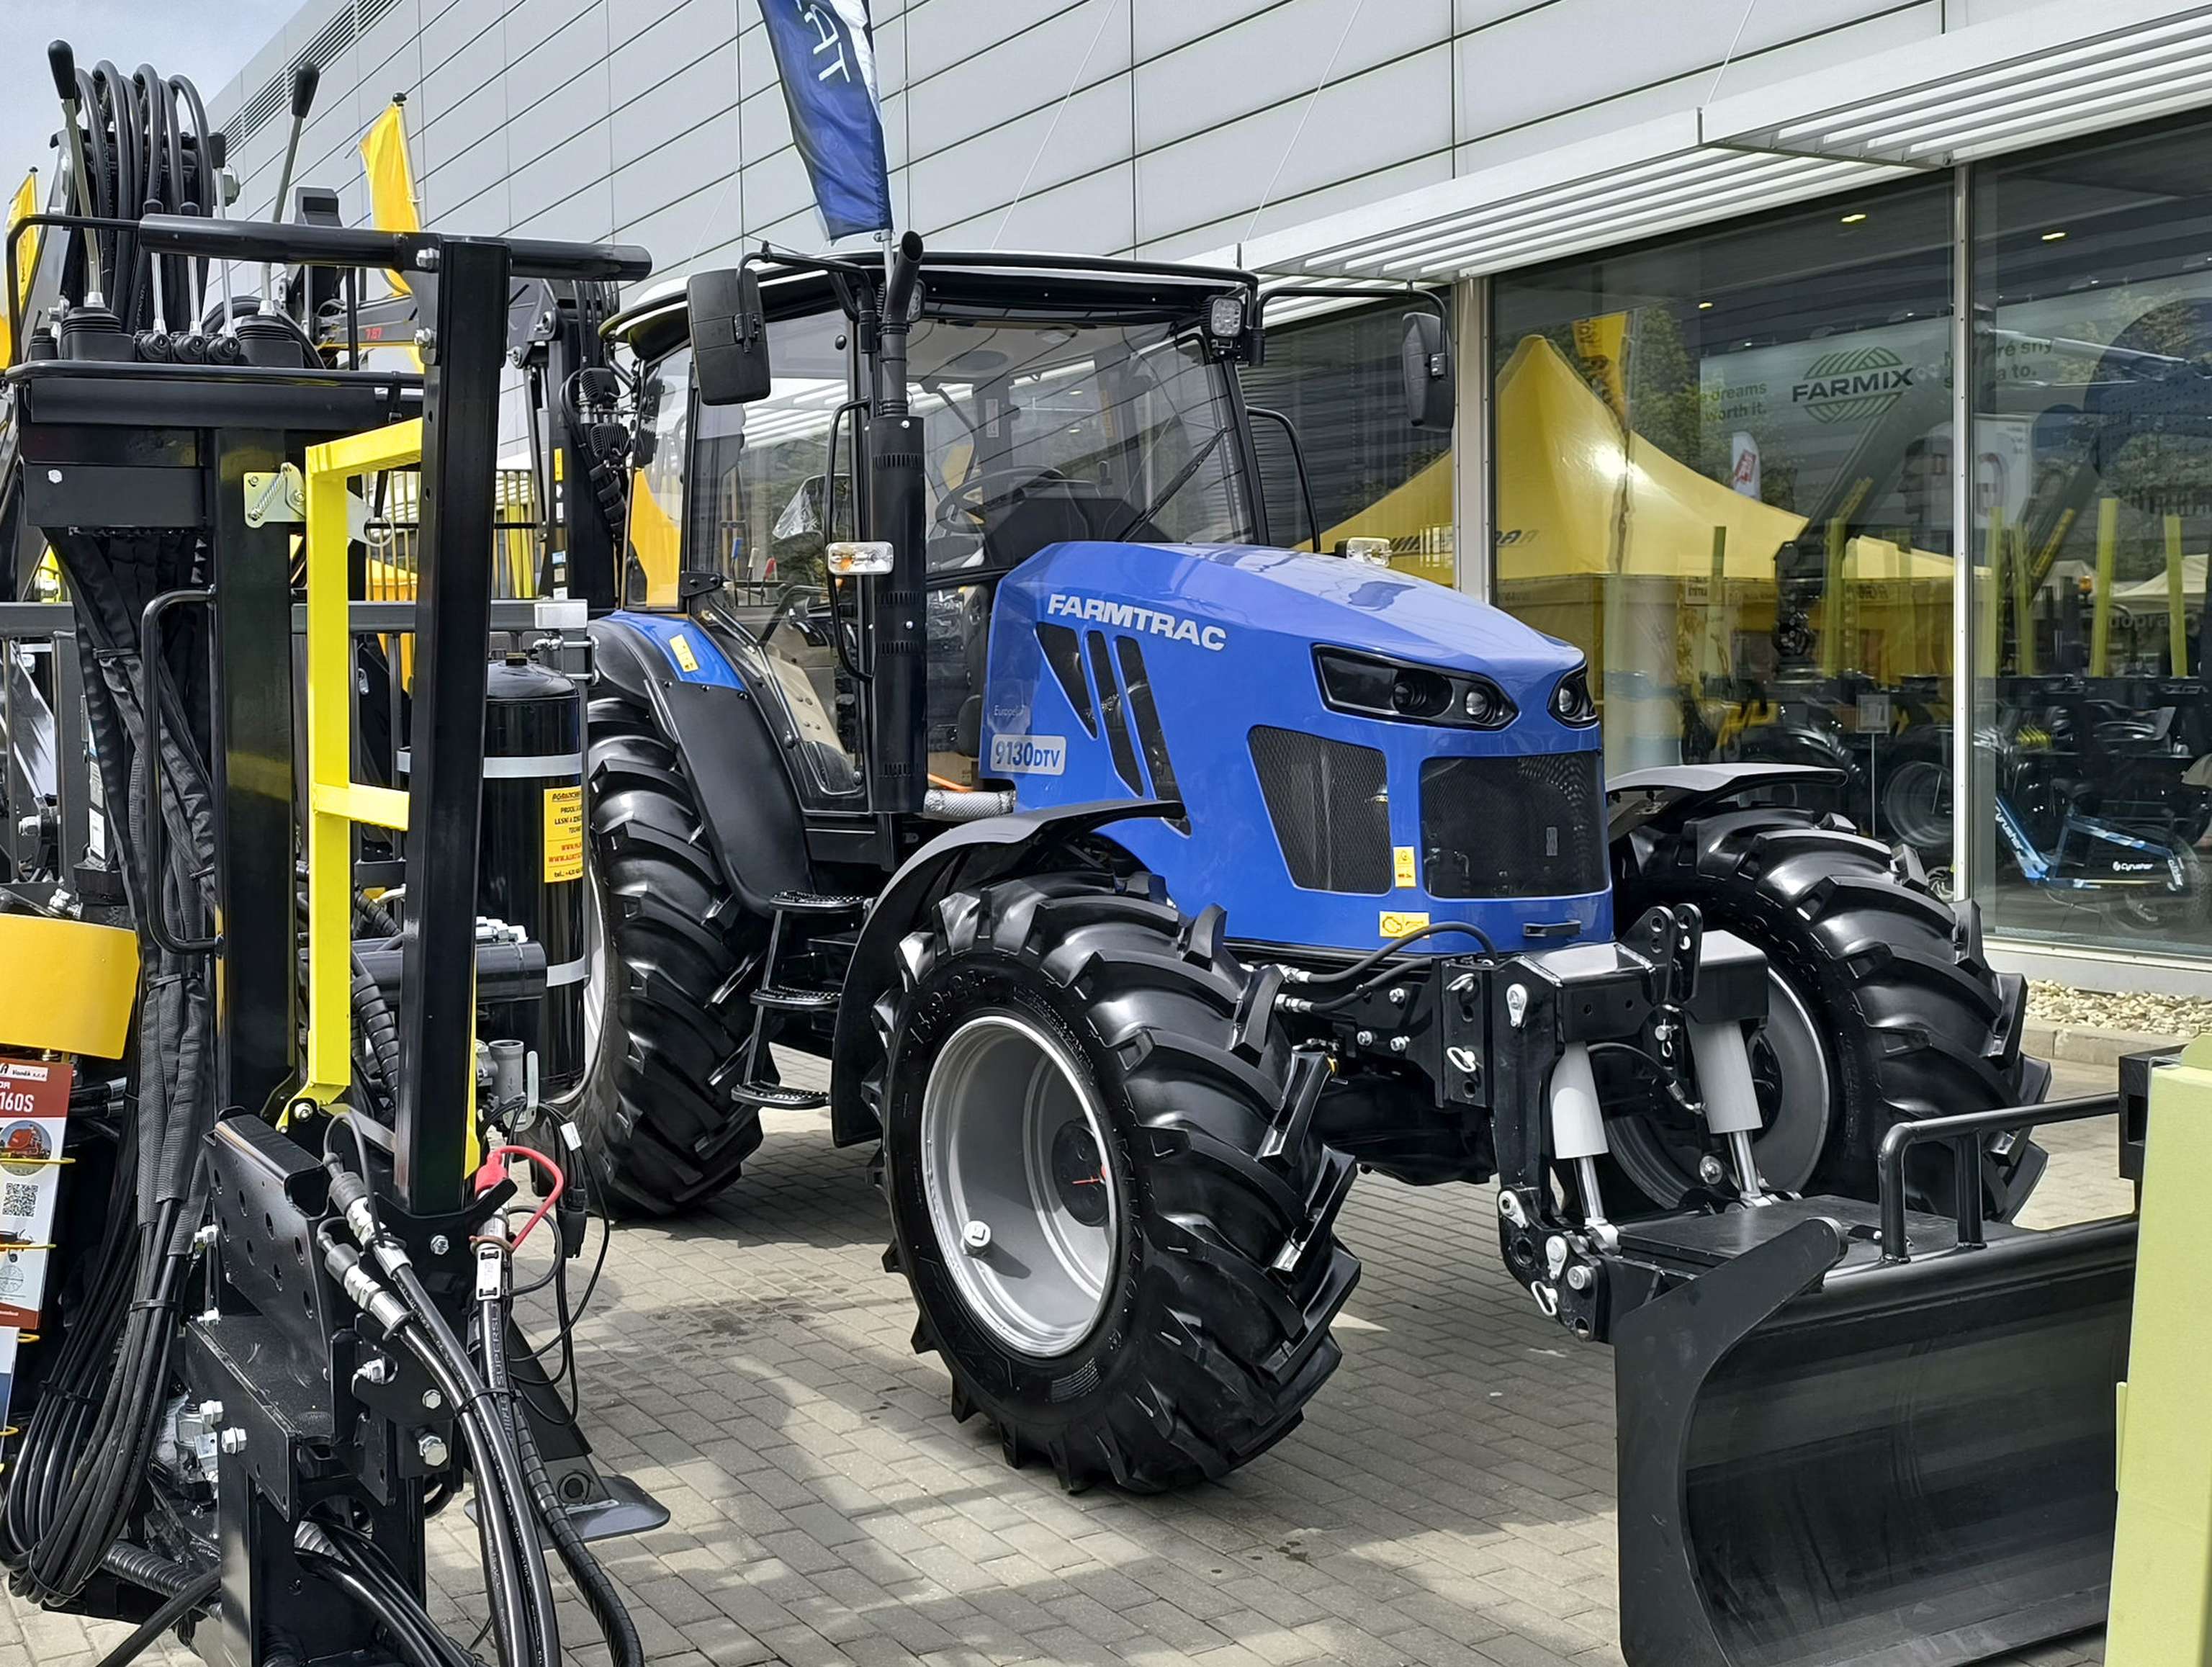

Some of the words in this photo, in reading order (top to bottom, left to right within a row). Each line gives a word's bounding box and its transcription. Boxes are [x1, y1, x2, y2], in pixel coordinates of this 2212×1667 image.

[1711, 382, 1768, 402] dreams
[1792, 367, 1913, 403] FARMIX
[1047, 593, 1226, 652] FARMTRAC
